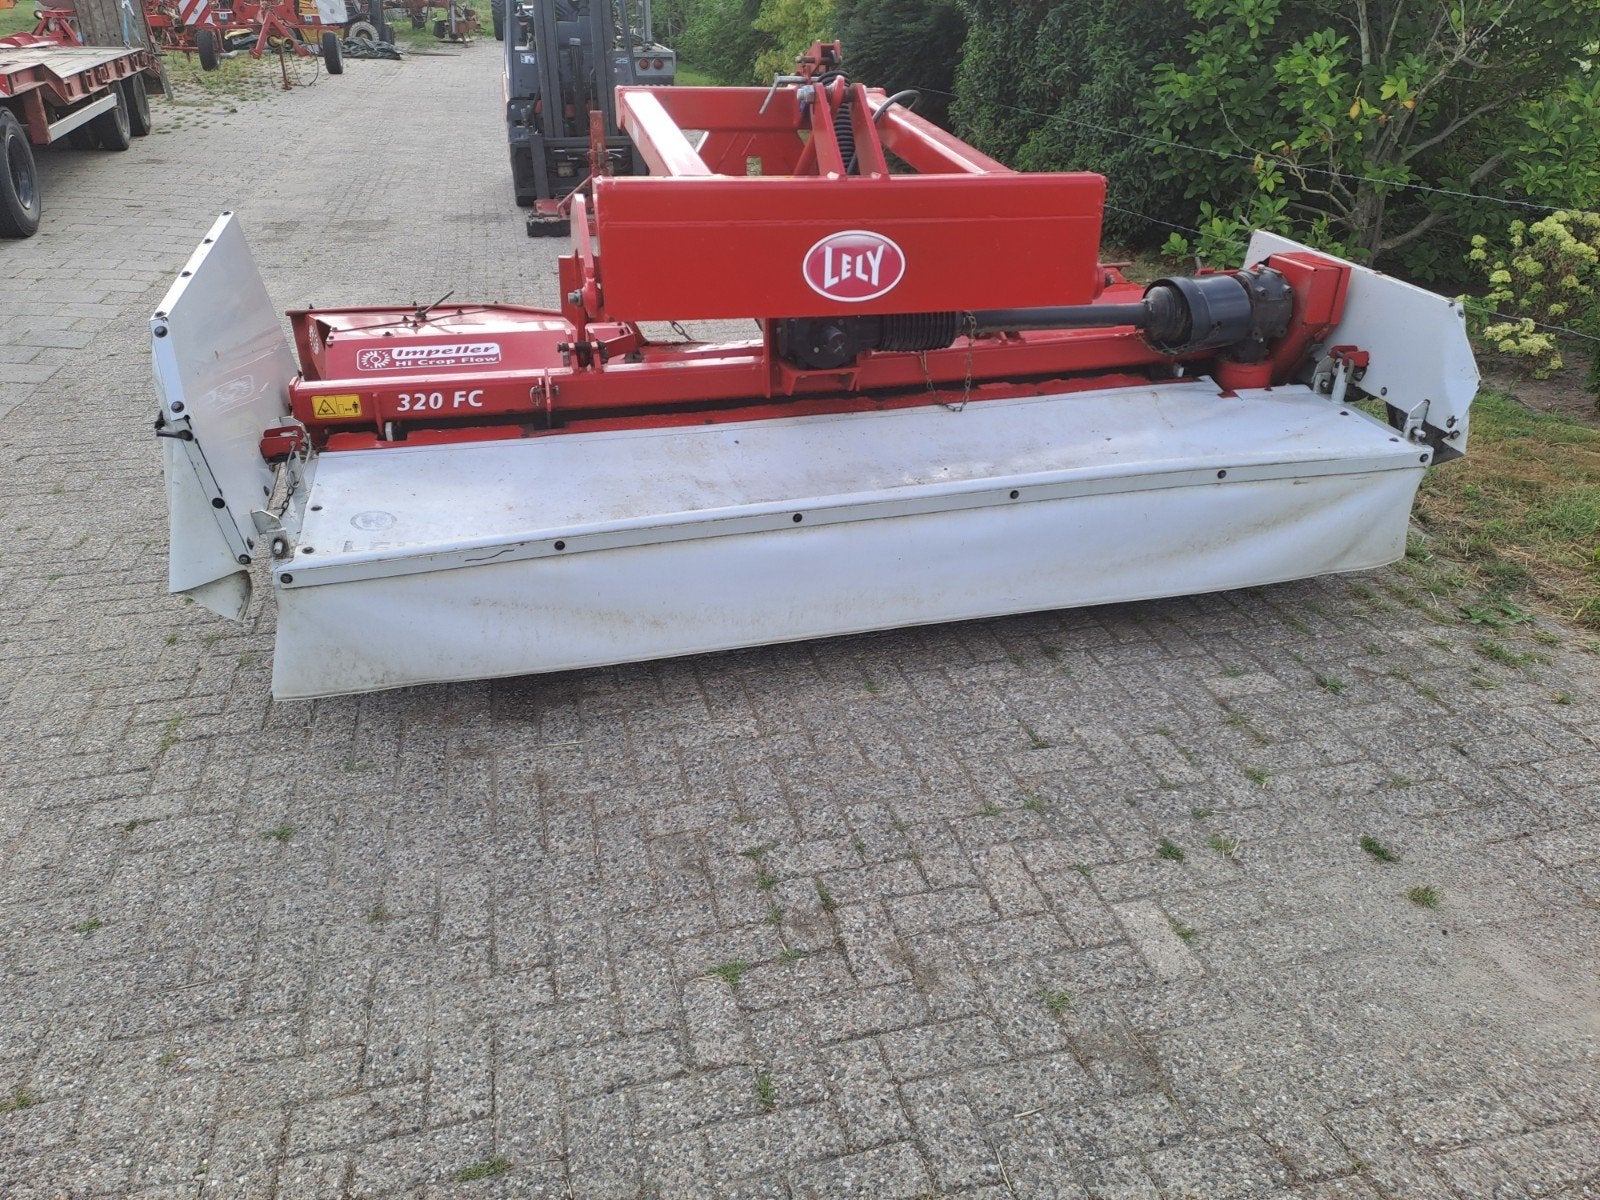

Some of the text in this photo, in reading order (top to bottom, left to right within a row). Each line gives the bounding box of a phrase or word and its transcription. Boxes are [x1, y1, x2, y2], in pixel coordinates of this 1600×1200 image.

[824, 244, 885, 289] LELY
[396, 345, 495, 358] Impeller
[417, 358, 456, 366] Crop
[461, 356, 497, 364] Flow
[396, 389, 484, 411] 320 FC
